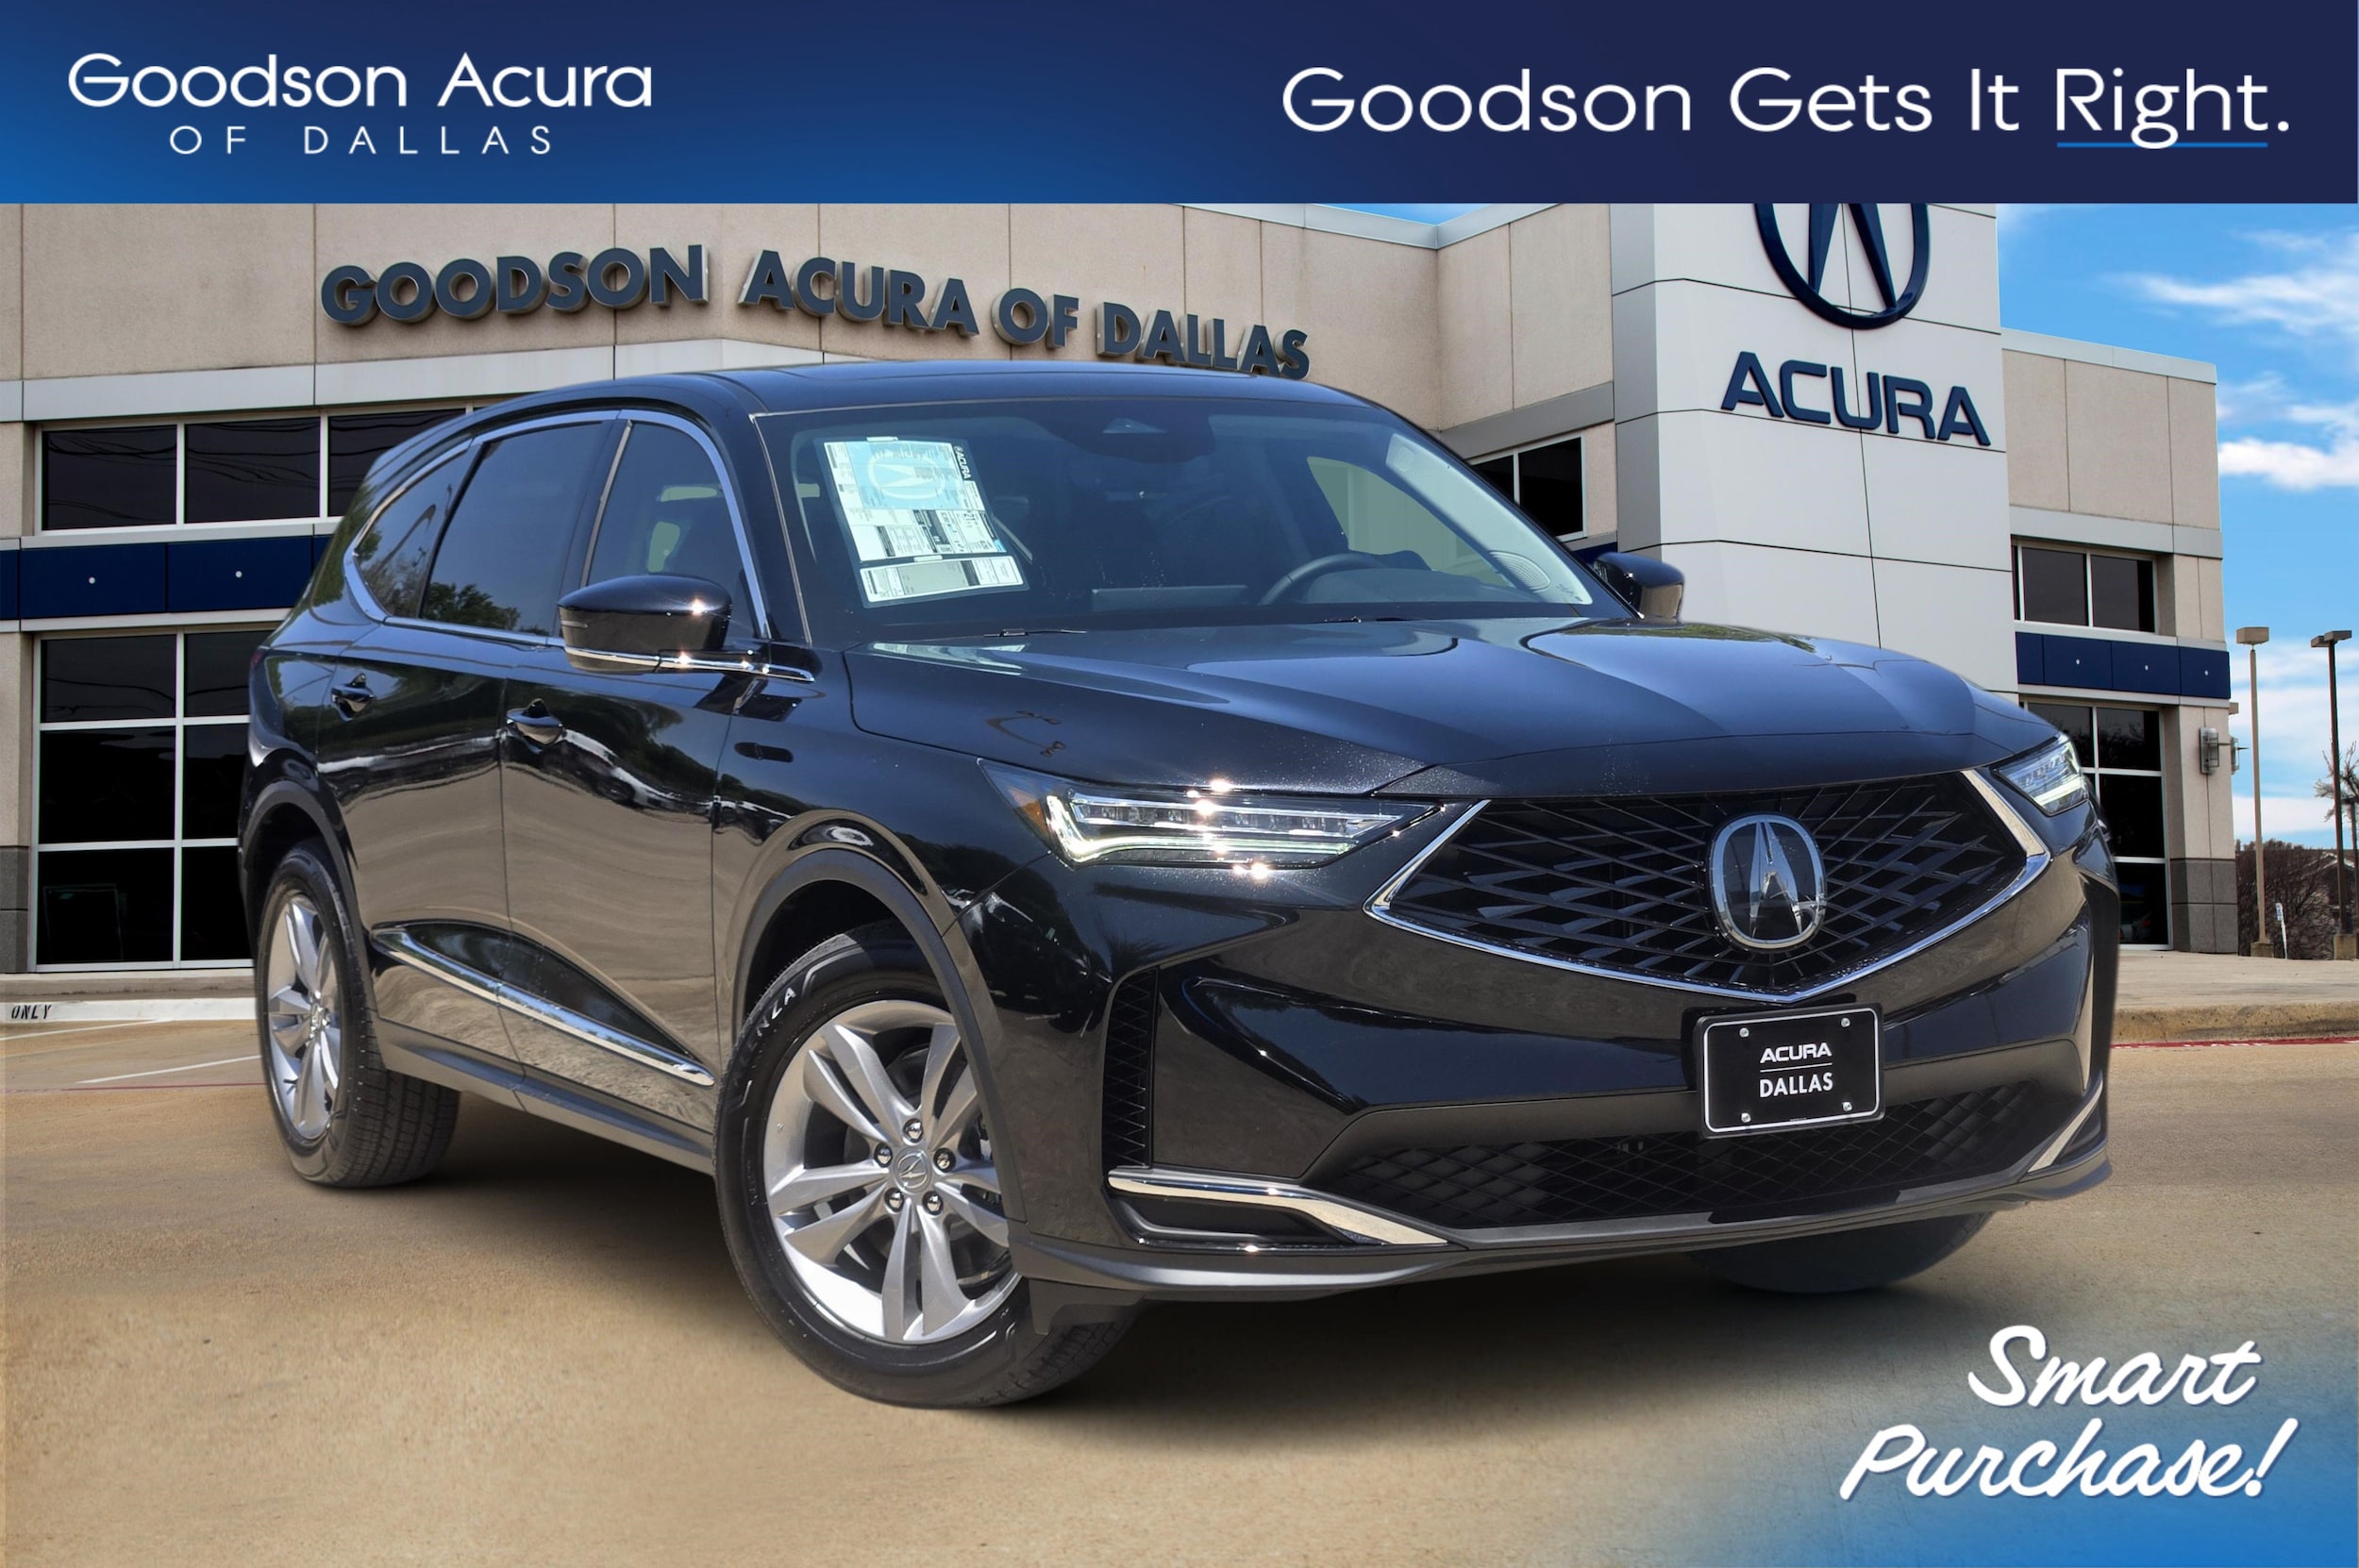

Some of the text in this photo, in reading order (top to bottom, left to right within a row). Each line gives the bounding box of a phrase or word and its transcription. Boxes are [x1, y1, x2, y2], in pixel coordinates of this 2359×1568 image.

[321, 244, 1311, 379] GOODSON ACURA OF DALLAS
[1721, 350, 1991, 446] ACURA
[956, 450, 971, 480] ACURA
[11, 1004, 52, 1020] ONLY
[1760, 1042, 1832, 1064] ACURA
[1759, 1072, 1834, 1098] DALLAS
